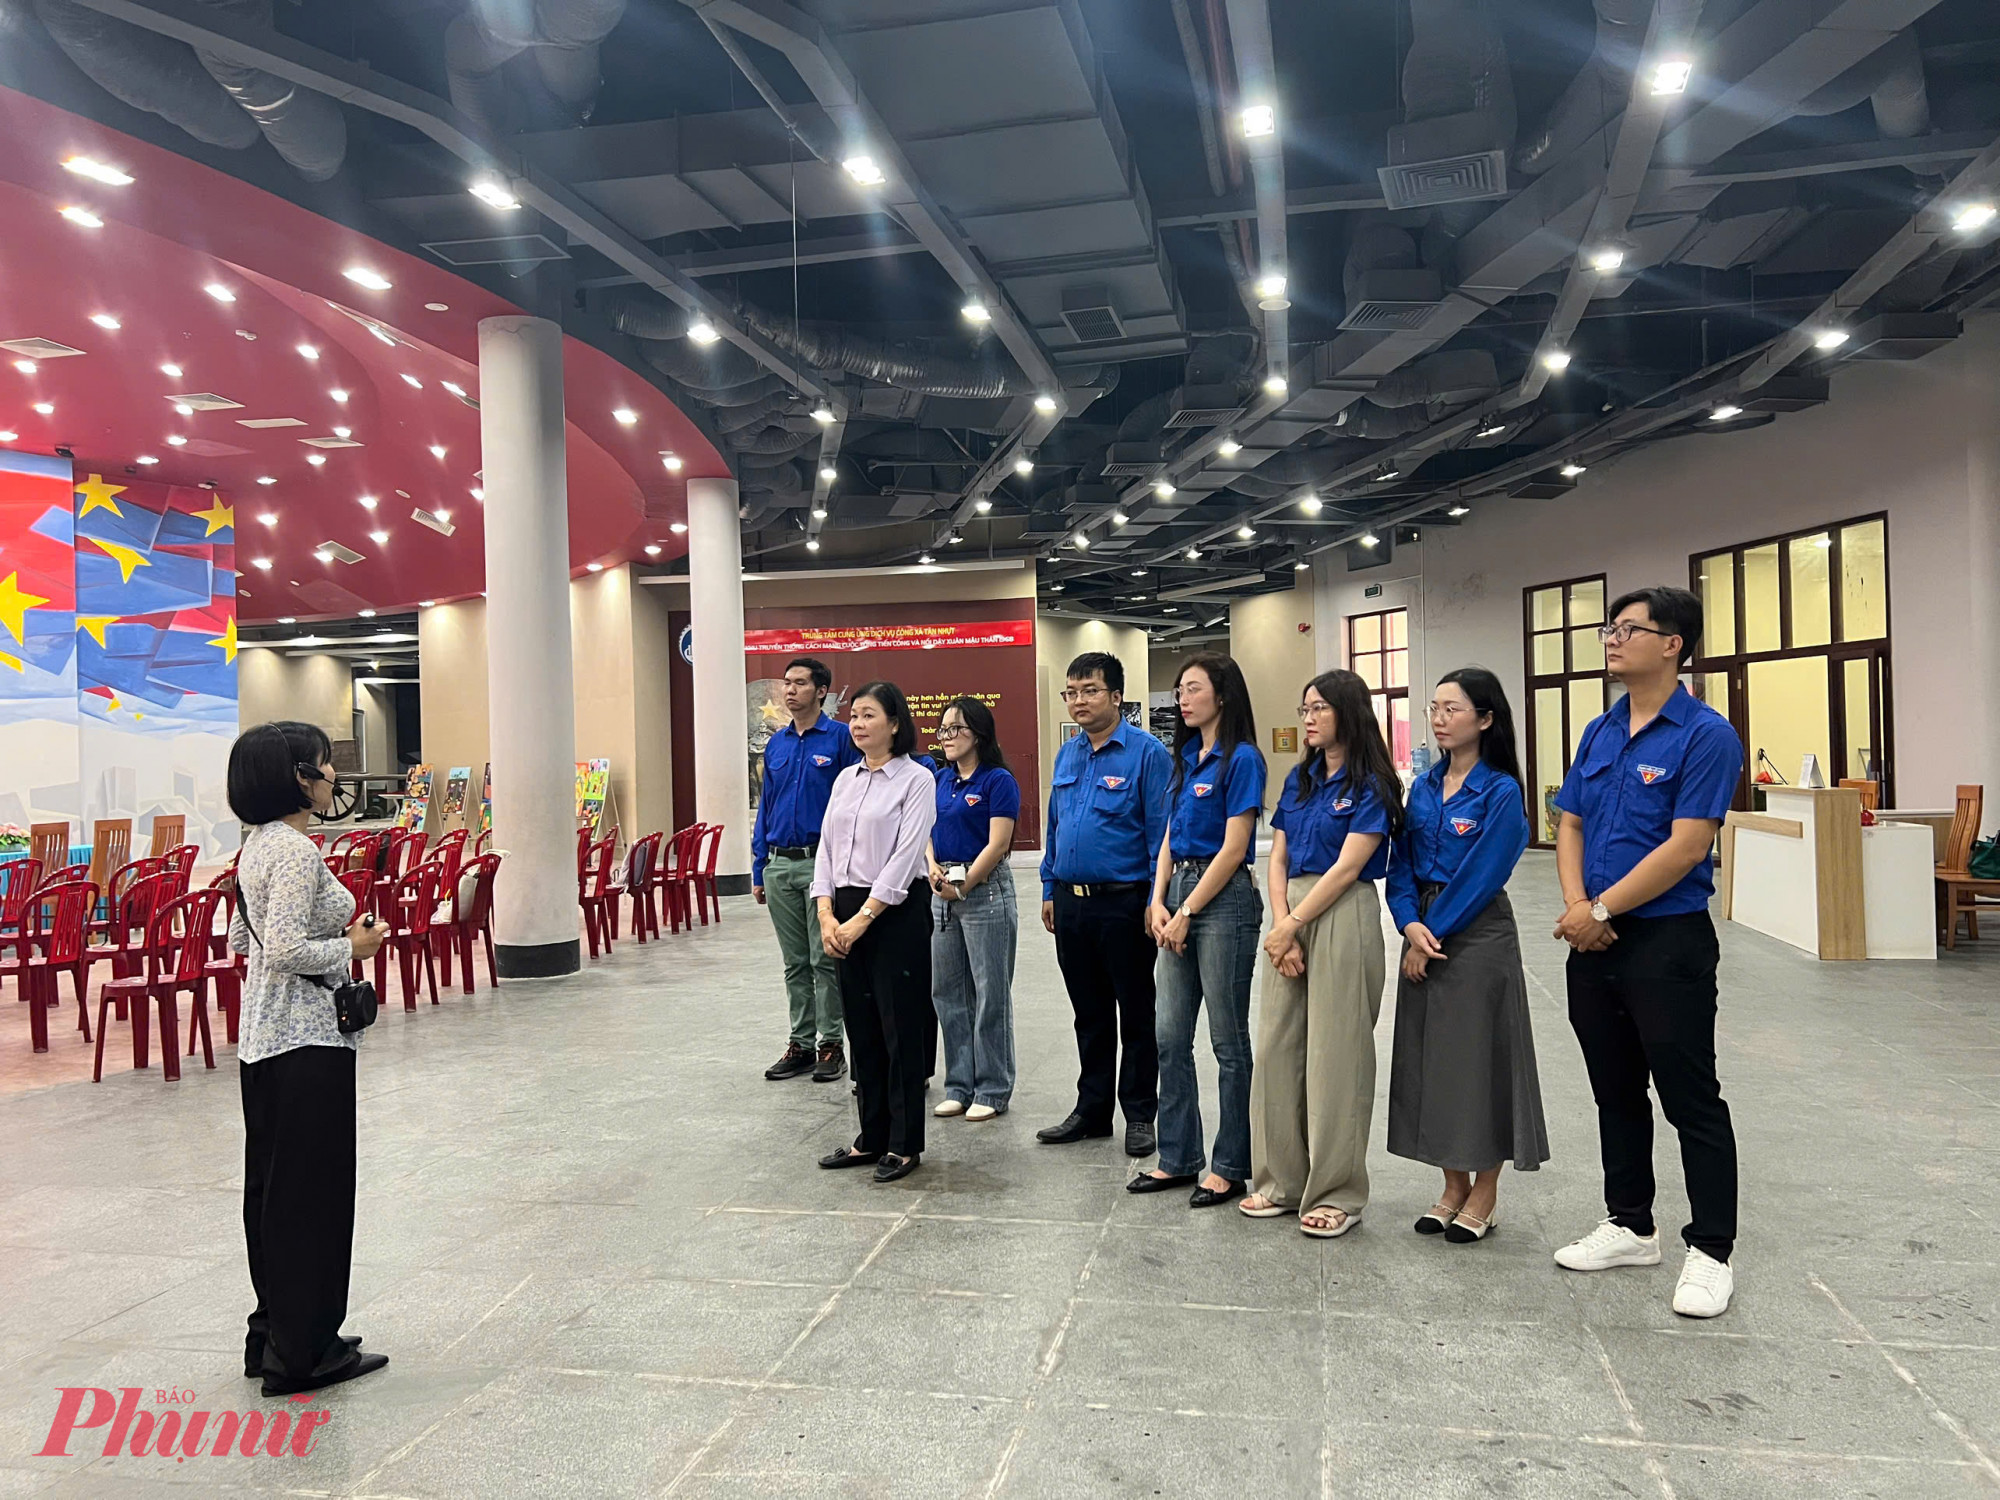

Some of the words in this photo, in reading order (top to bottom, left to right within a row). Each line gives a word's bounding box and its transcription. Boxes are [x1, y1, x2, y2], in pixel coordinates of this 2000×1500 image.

[805, 641, 822, 649] CÁCH
[946, 635, 964, 644] XUÂN
[906, 694, 919, 702] này
[986, 692, 1001, 700] qua
